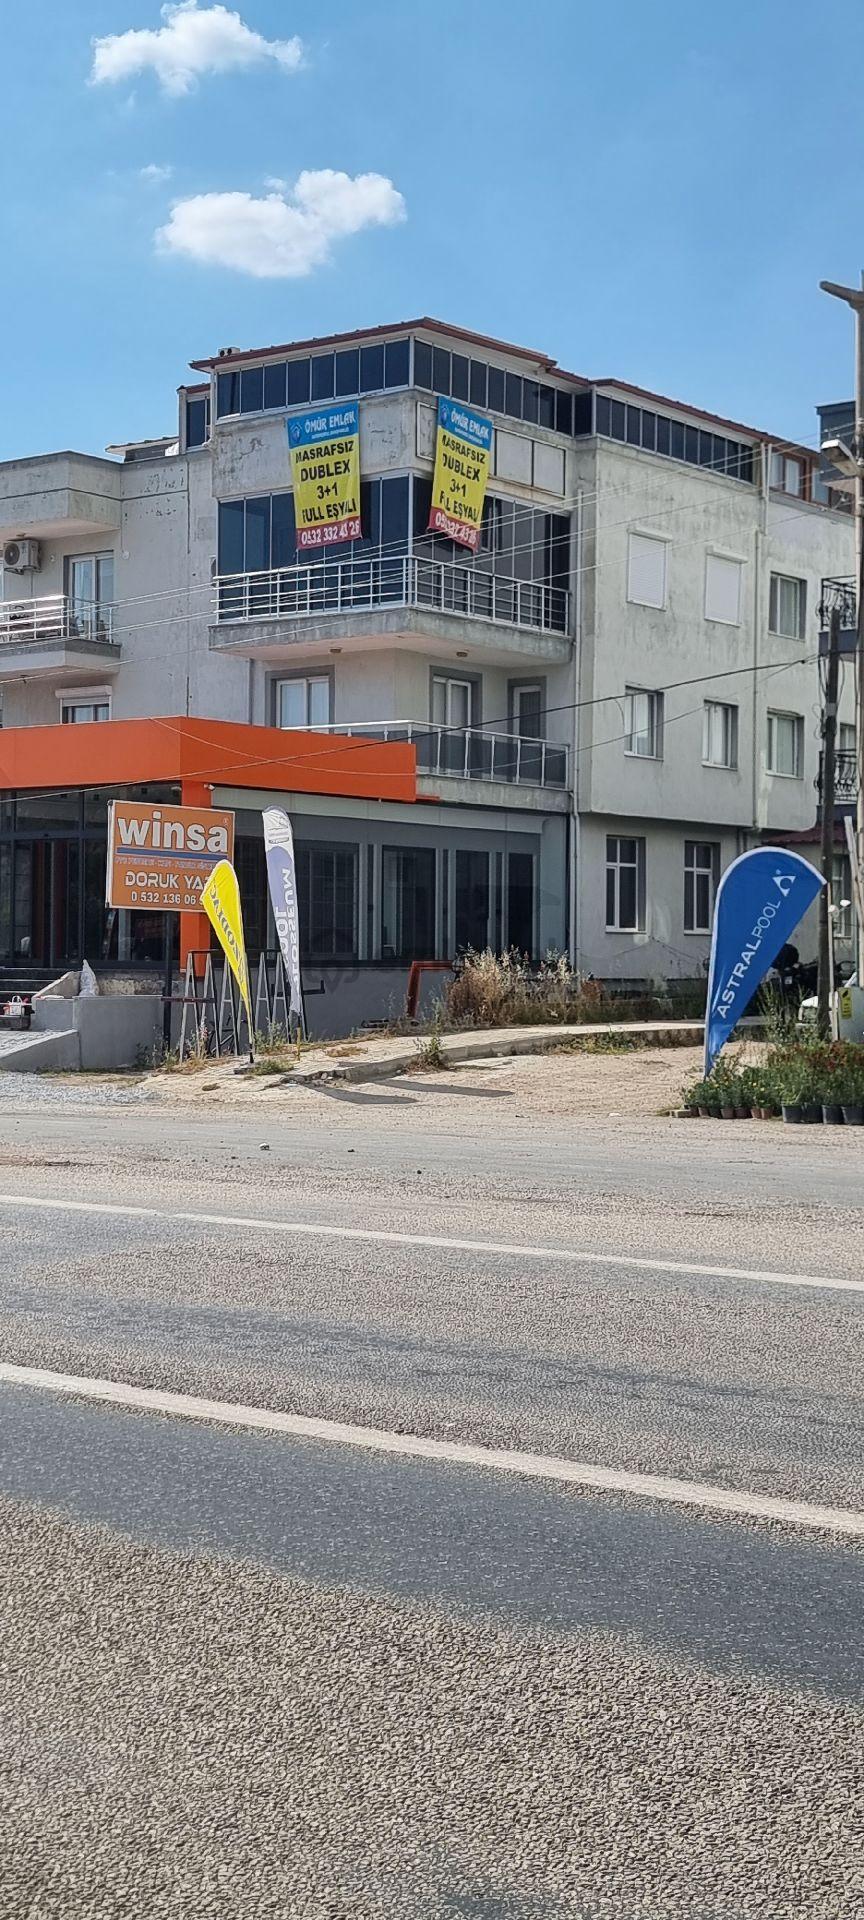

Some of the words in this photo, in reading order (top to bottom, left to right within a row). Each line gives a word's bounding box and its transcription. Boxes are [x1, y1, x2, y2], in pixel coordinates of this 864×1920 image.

[305, 417, 327, 433] ÖMÜR
[329, 411, 356, 428] EMLAK
[296, 441, 354, 463] MASRAFSIZ
[300, 459, 350, 482] DUBLEX
[317, 482, 338, 499] 3+1
[450, 479, 466, 497] 3+1
[323, 526, 338, 541] 332
[117, 810, 229, 853] winsa
[125, 870, 179, 889] DORUK
[131, 891, 138, 902] 0
[140, 891, 160, 903] 532
[163, 893, 181, 904] 136
[184, 894, 197, 905] 06
